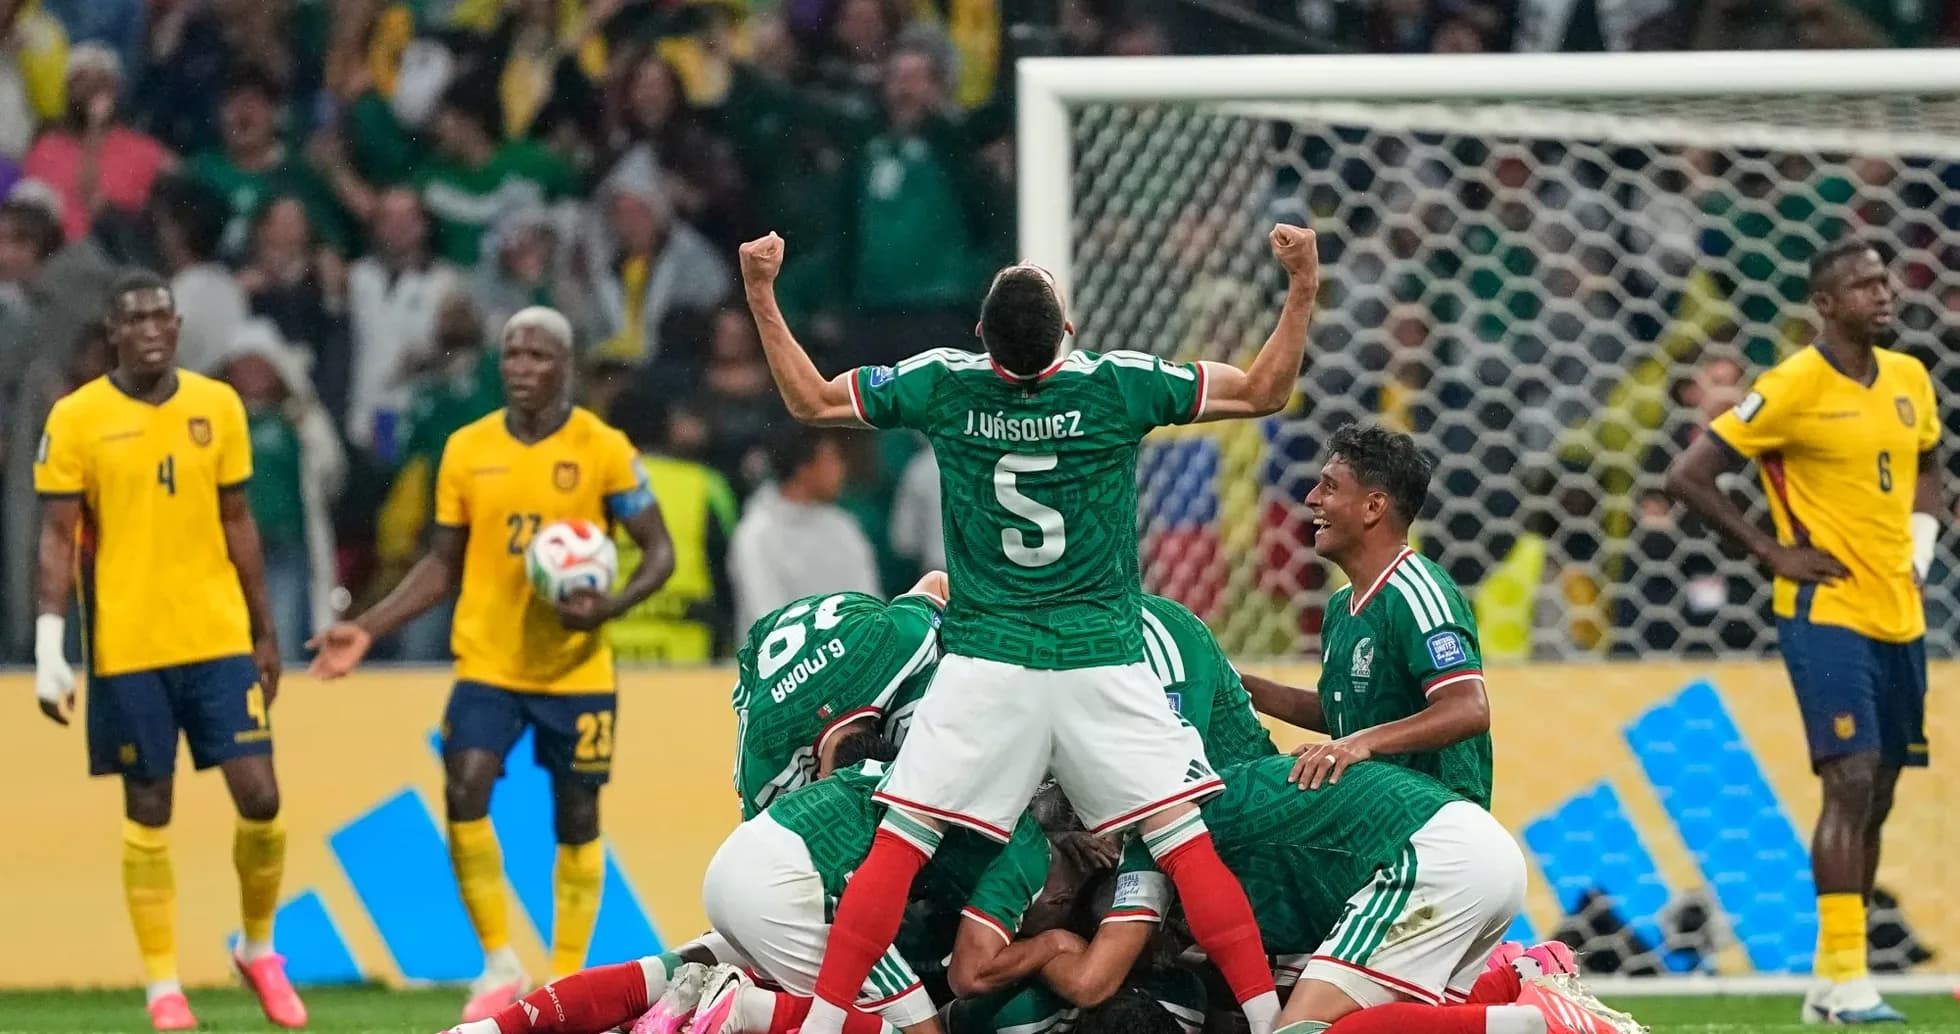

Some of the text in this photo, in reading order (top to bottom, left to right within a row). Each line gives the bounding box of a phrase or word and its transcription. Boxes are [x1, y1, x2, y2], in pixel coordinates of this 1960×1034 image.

[157, 454, 176, 496] 4
[1878, 451, 1892, 492] 6
[993, 452, 1067, 568] 5
[771, 637, 846, 704] G.MORA
[246, 681, 267, 729] 4
